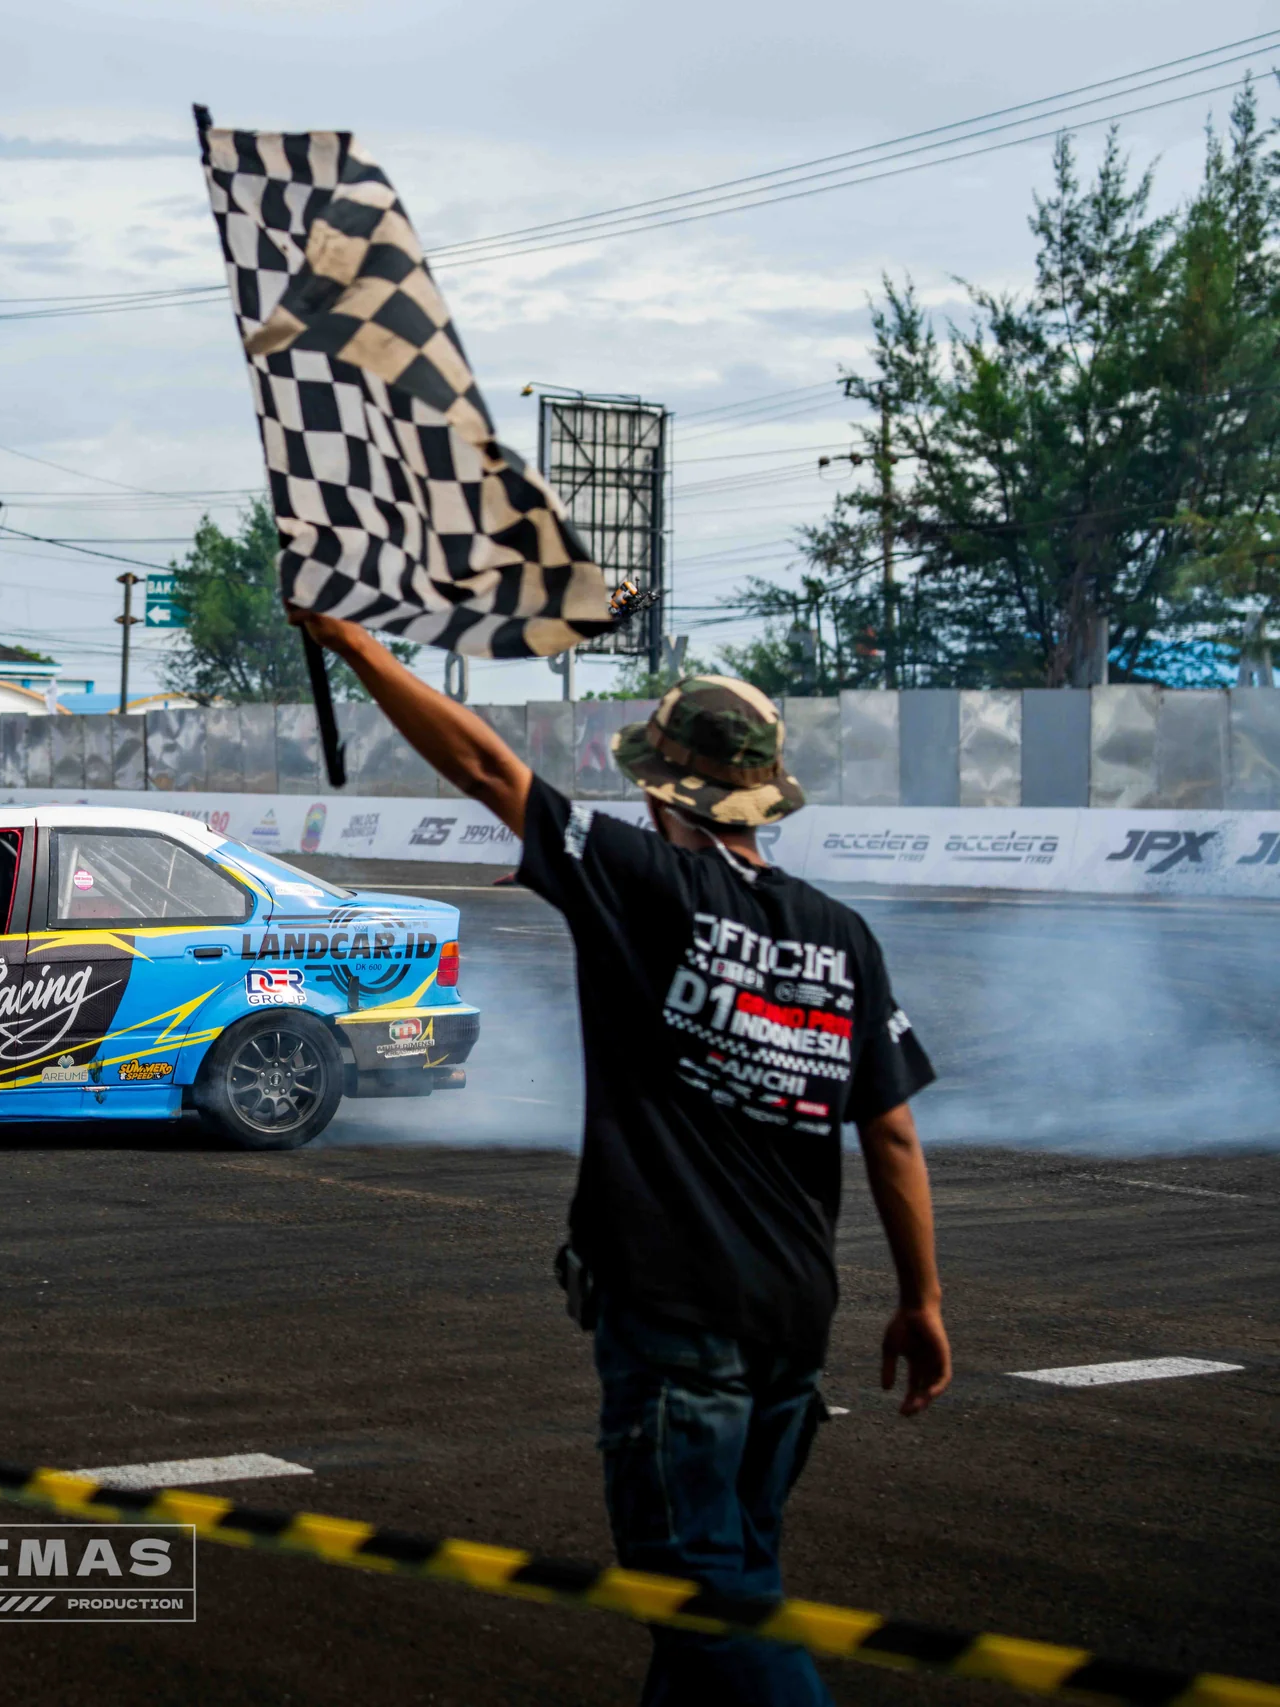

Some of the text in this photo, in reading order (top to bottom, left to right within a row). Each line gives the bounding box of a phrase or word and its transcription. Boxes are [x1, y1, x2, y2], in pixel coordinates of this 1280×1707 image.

[822, 829, 931, 850] accelera
[944, 830, 1060, 852] accelera
[1105, 829, 1220, 874] JPX
[240, 933, 438, 960] LANDCAR.ID
[355, 963, 382, 971] DK 600
[665, 965, 737, 1030] D1
[729, 1009, 852, 1062] INDONESIA
[119, 1059, 173, 1075] SUMMER
[126, 1072, 154, 1080] SPEED
